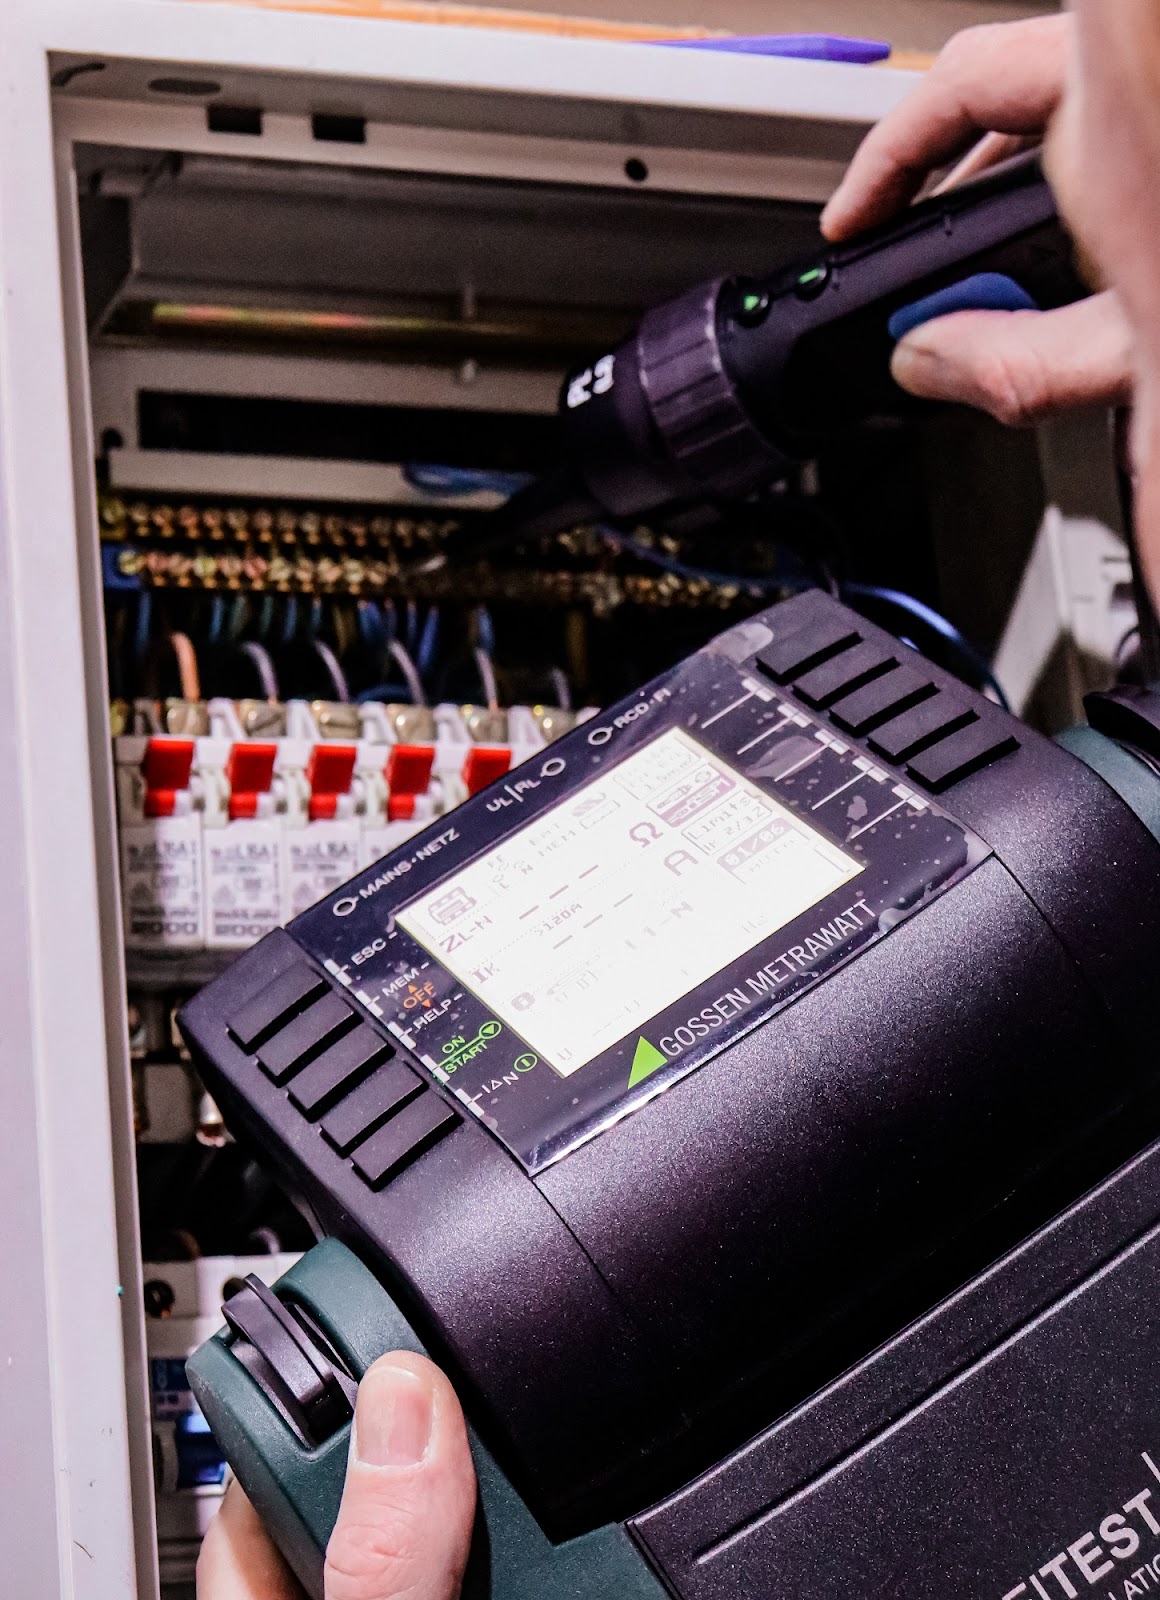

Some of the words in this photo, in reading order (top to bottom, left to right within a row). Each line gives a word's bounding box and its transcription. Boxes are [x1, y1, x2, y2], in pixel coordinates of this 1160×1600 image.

[664, 850, 699, 876] A
[351, 938, 387, 966] ESC
[382, 967, 419, 996] MEM
[660, 988, 752, 1057] GOSSEN
[746, 899, 876, 996] METRAWATT
[403, 982, 435, 1009] OFF
[413, 998, 452, 1030] HELP
[442, 1035, 465, 1054] ON
[445, 1040, 488, 1074] START
